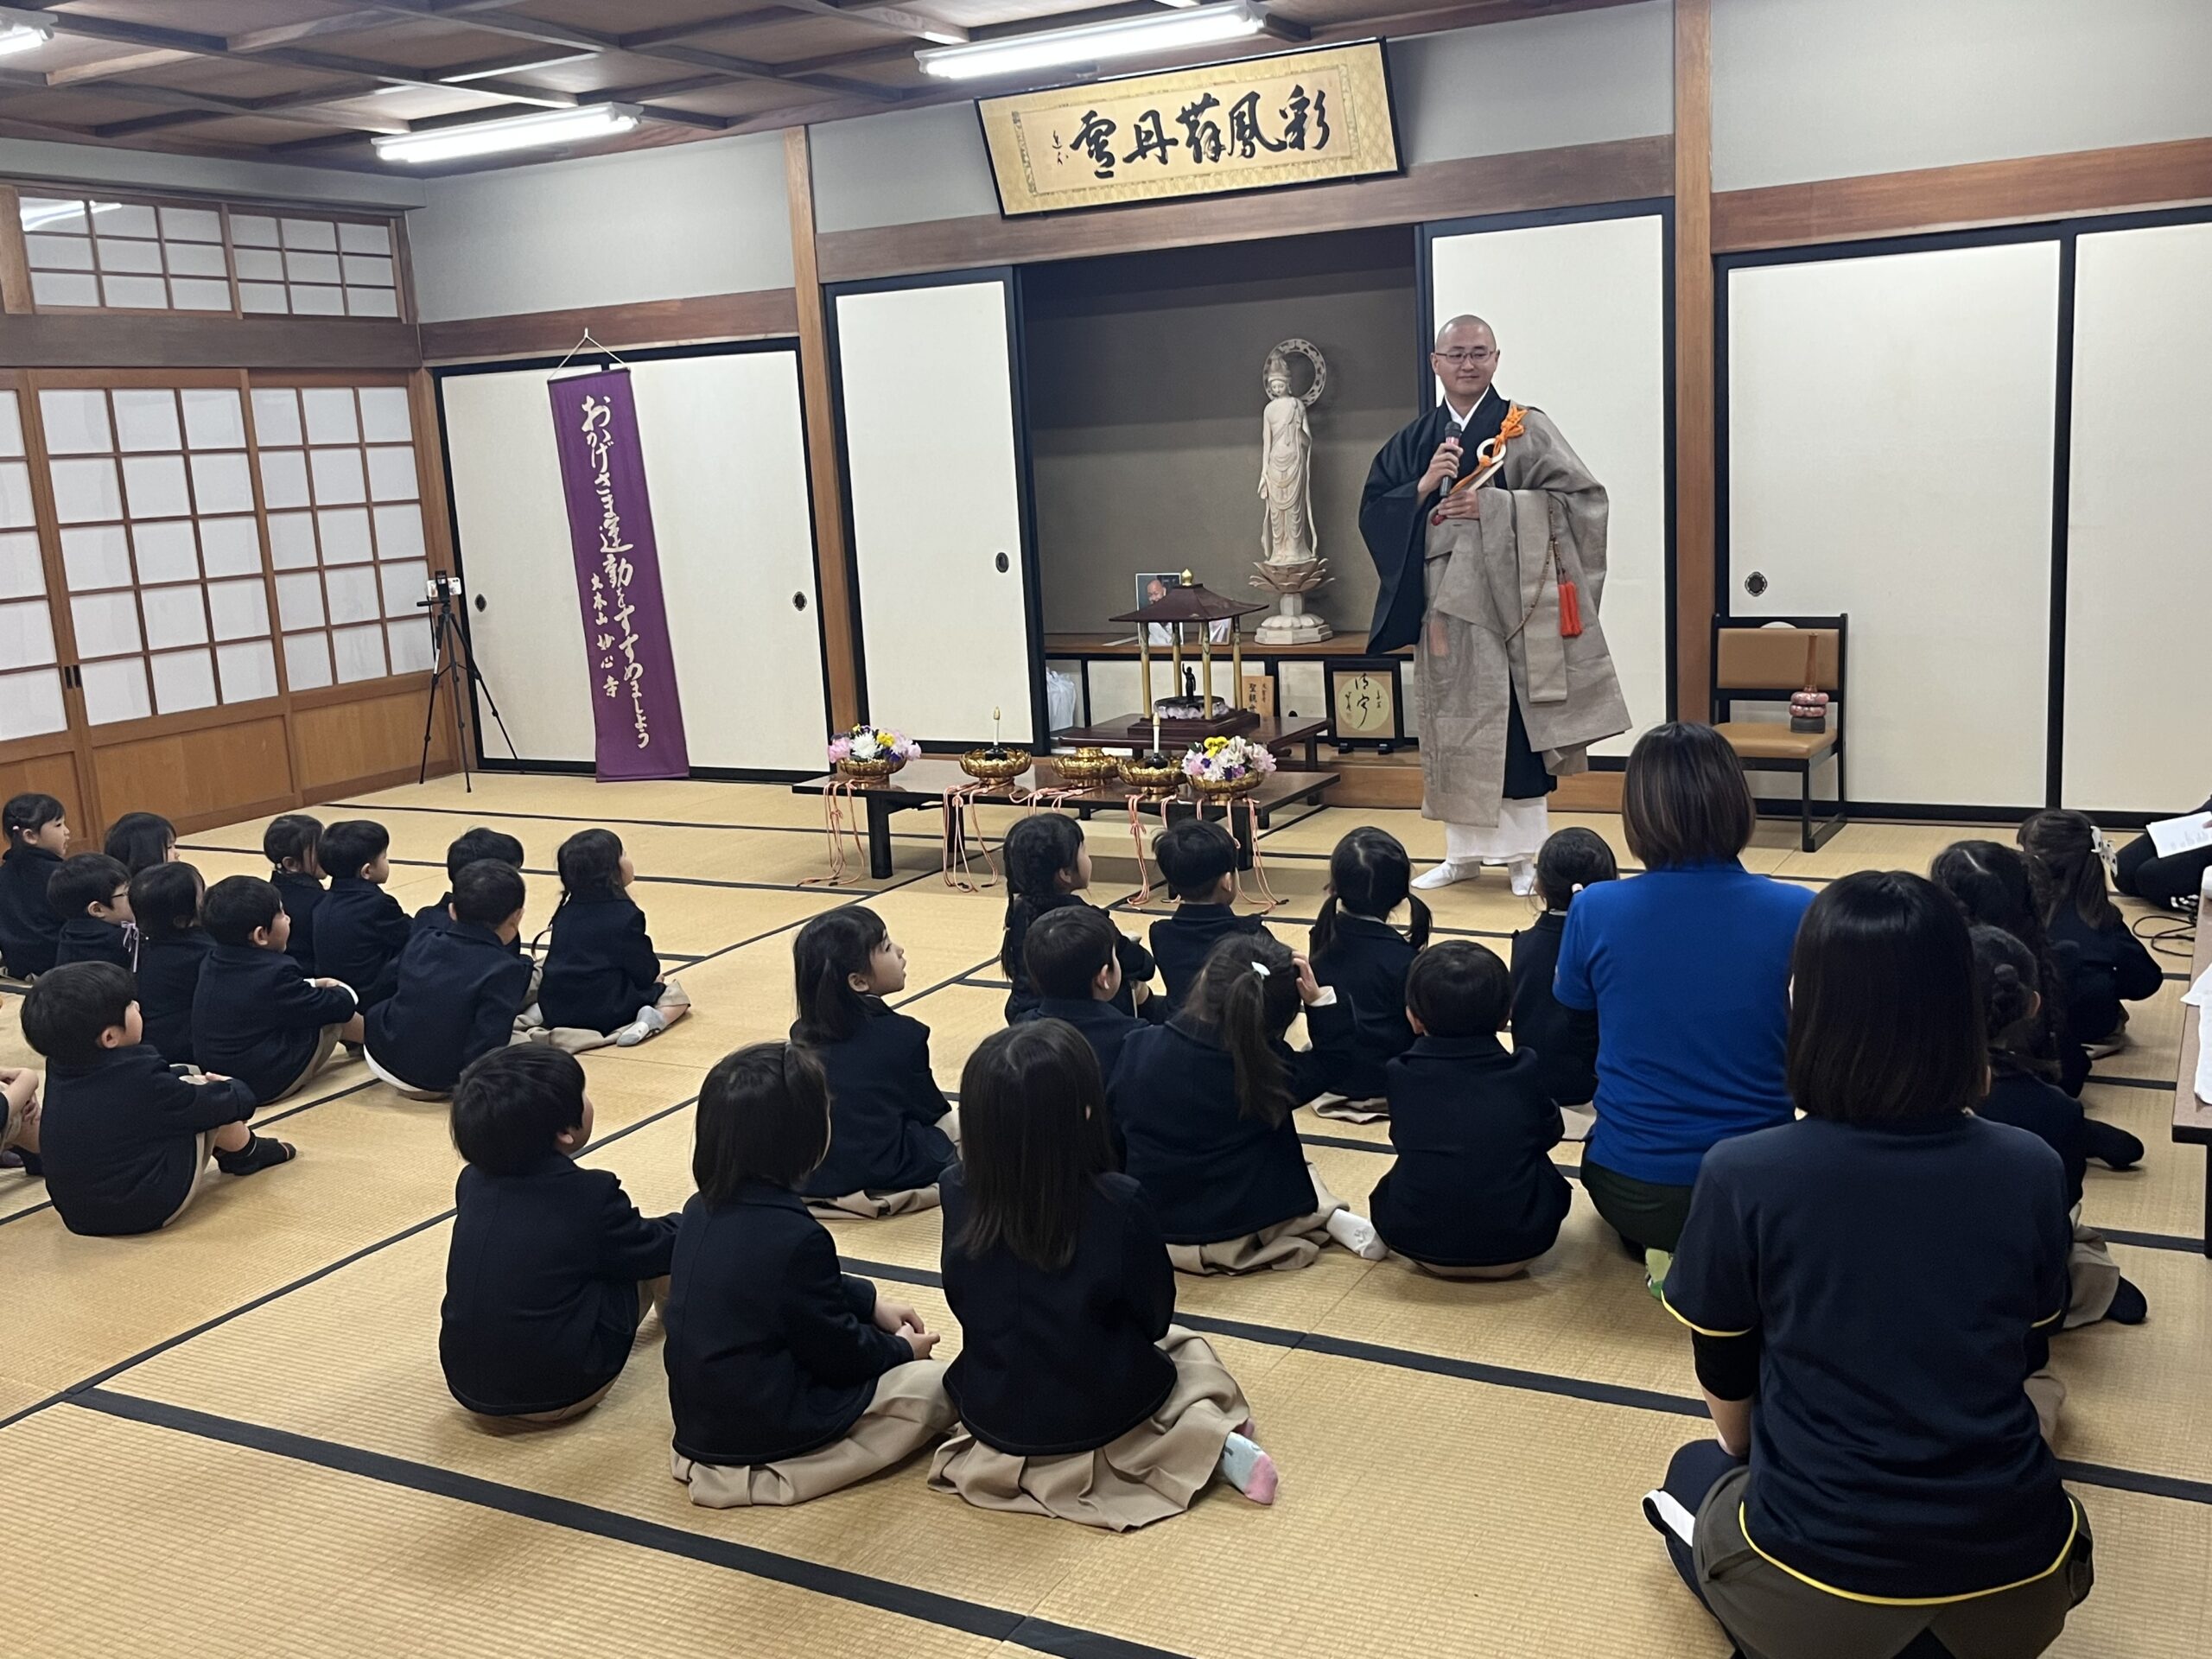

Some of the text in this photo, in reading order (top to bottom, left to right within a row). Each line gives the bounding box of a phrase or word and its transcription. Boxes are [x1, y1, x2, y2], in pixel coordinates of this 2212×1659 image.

[581, 395, 650, 749] おかげさま運動をすすめましょう
[591, 573, 620, 698] 大本山妙心寺
